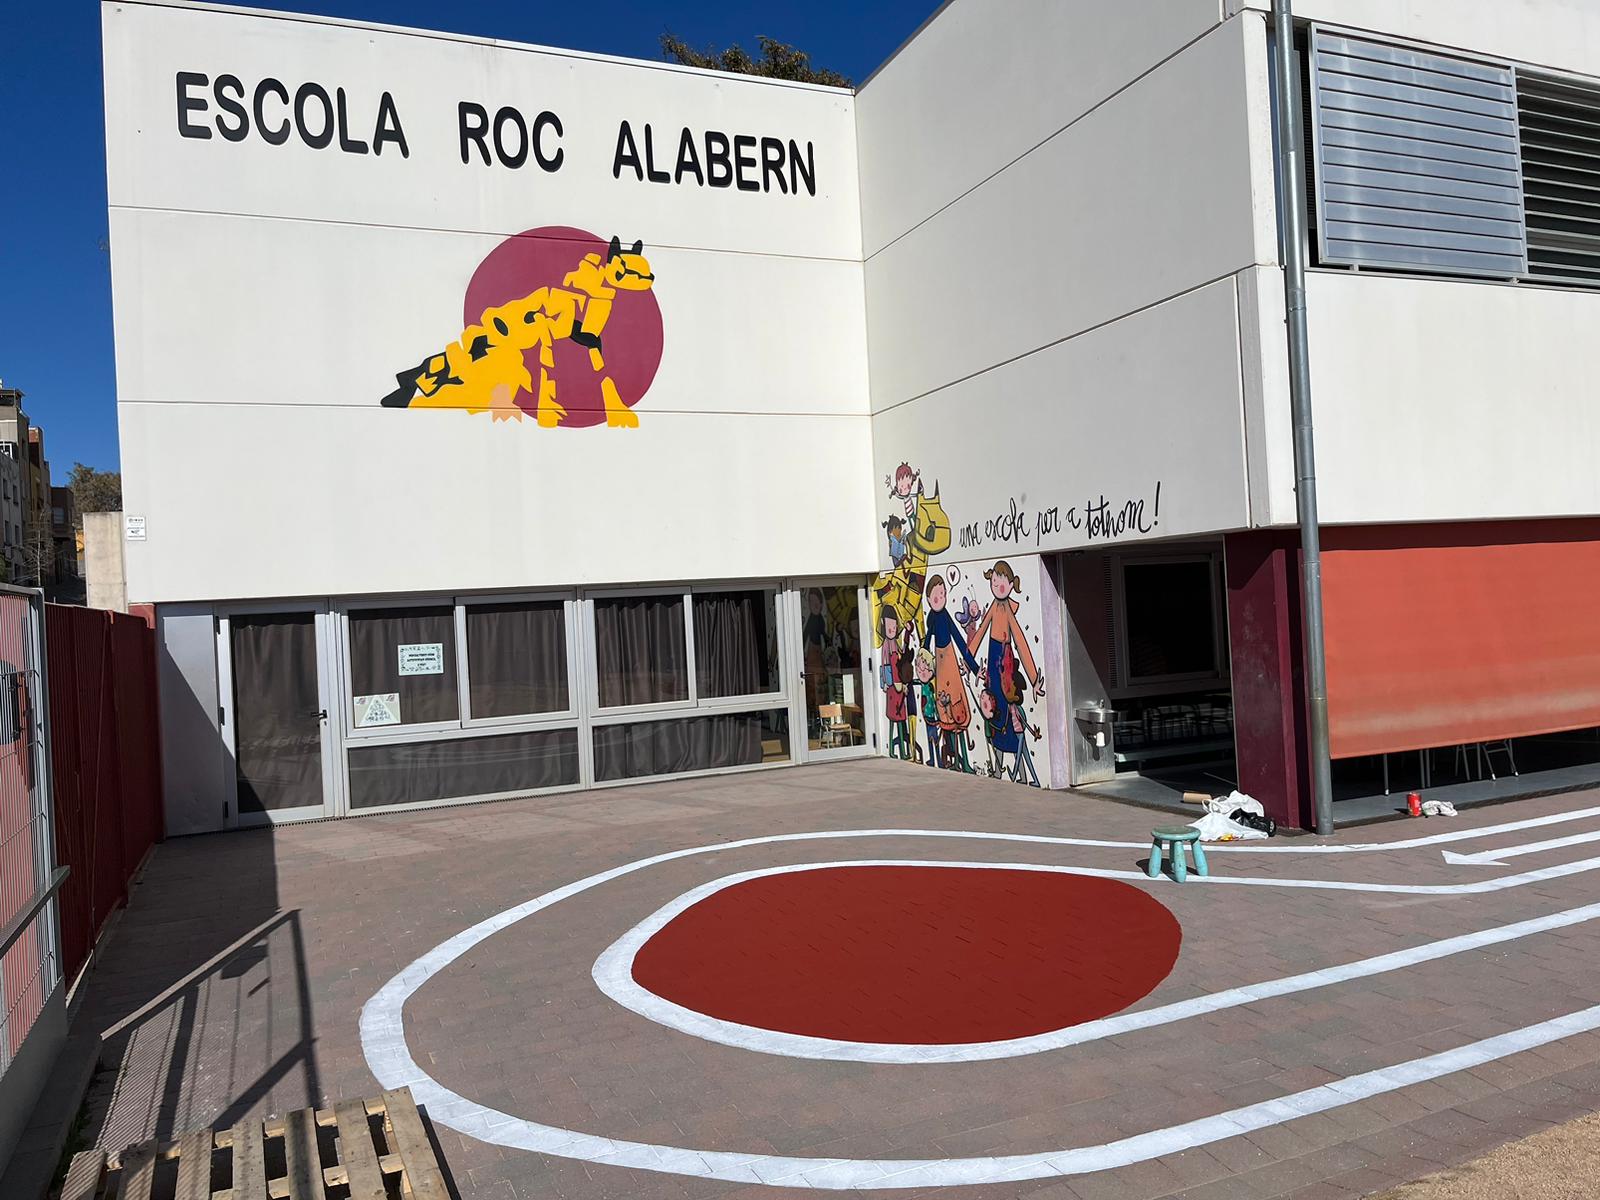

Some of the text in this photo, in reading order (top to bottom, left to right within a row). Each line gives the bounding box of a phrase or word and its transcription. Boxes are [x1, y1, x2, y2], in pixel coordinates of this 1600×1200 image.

[176, 72, 815, 196] ESCOLA ROC ALABERN
[959, 481, 1161, 548] una escola per a tothom!
